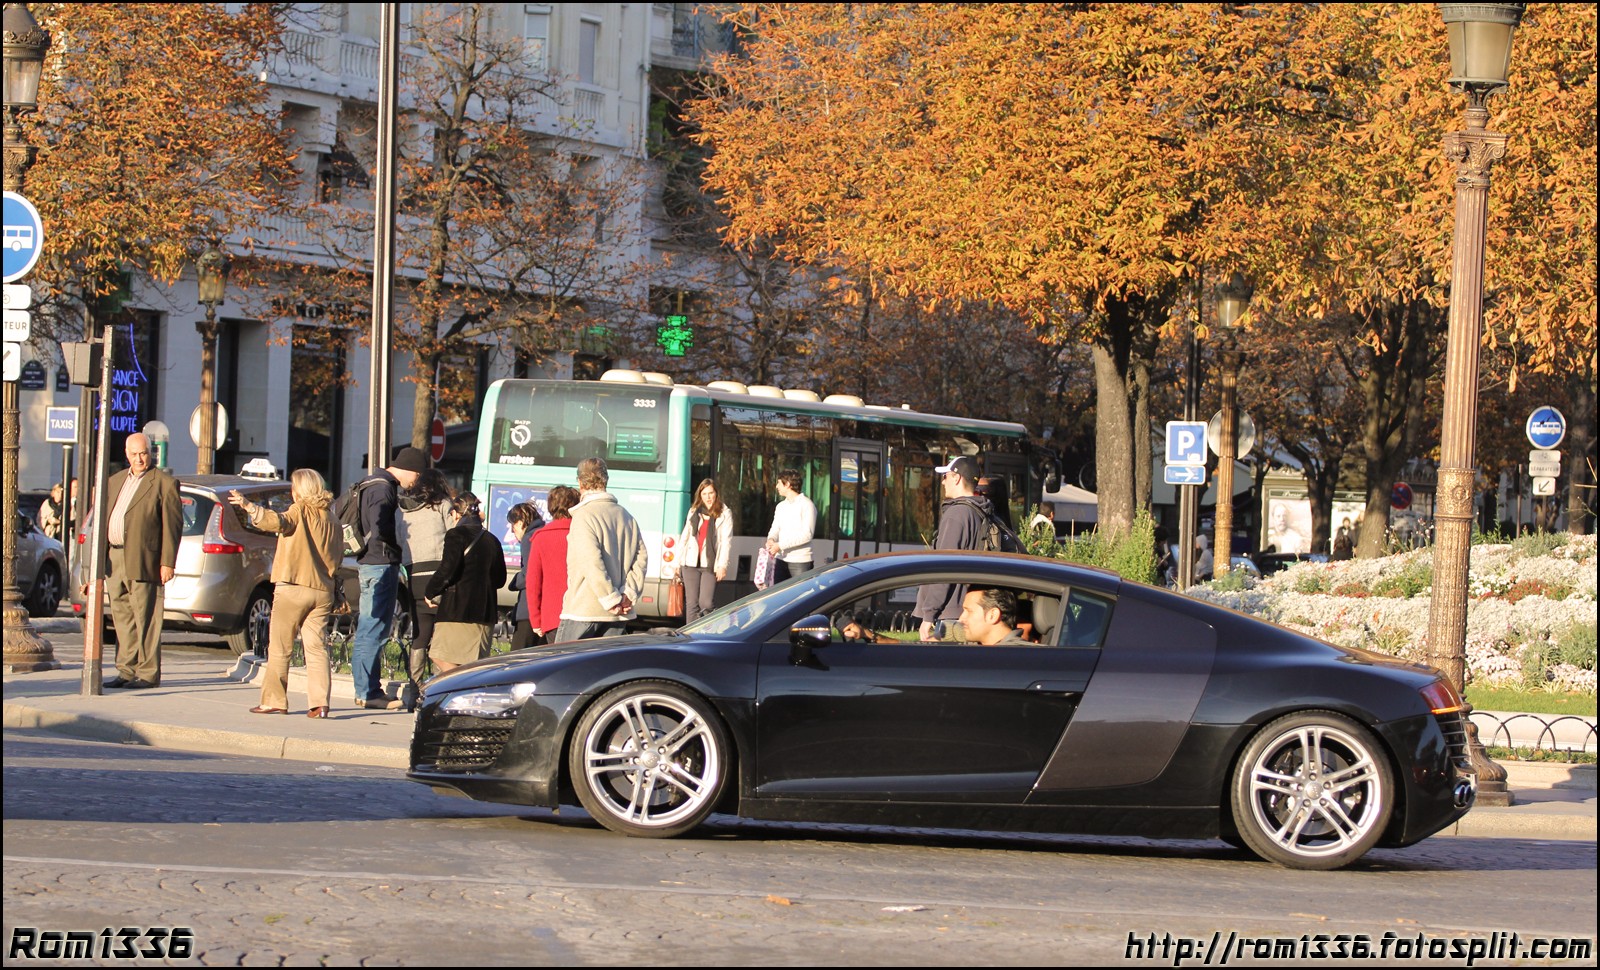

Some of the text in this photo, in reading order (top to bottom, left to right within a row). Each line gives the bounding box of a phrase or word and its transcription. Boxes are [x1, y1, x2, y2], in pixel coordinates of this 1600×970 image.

[633, 399, 657, 408] 3333
[50, 419, 74, 430] TAXIS
[1177, 430, 1196, 456] P
